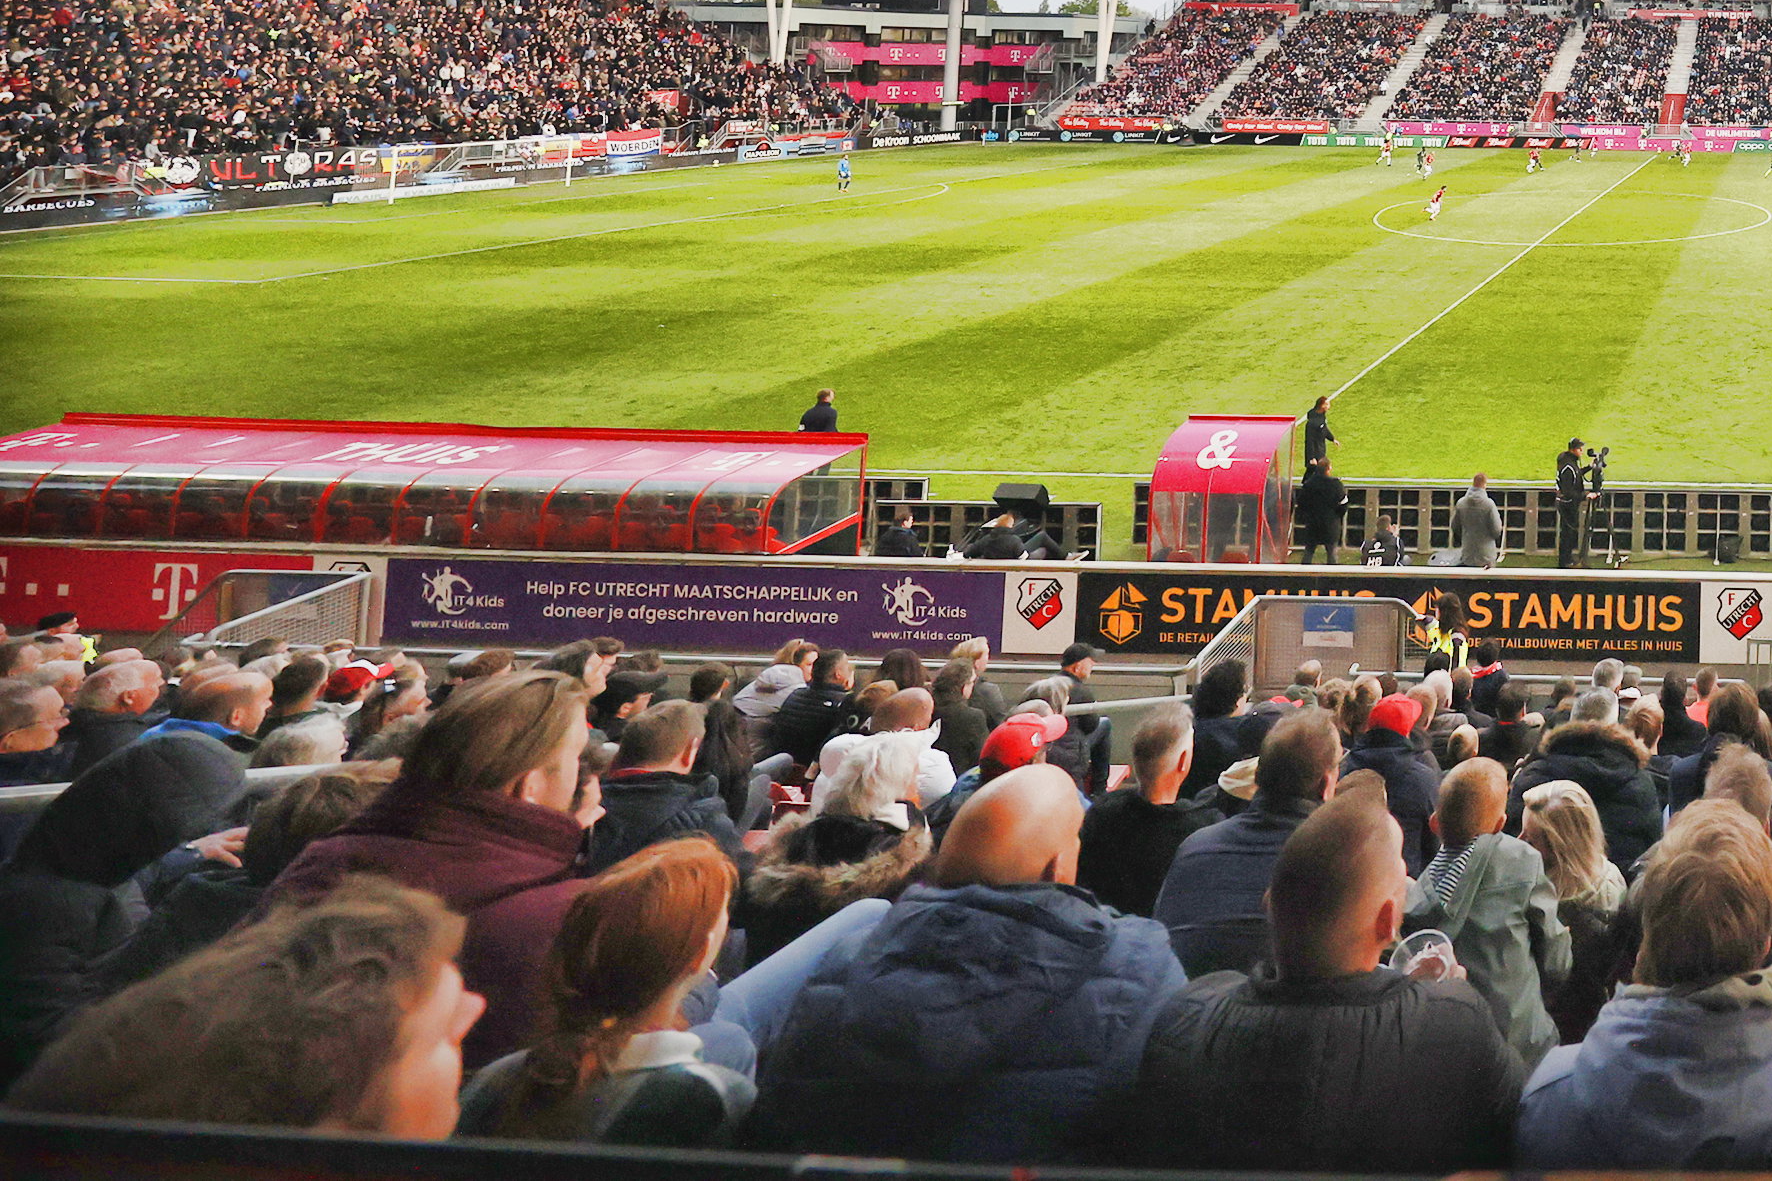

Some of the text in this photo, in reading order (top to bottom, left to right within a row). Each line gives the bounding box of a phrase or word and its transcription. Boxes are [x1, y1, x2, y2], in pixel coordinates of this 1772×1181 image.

[1226, 122, 1243, 131] Only
[1277, 123, 1293, 132] Only
[1580, 127, 1626, 136] WELKOM BIJ
[913, 133, 961, 145] SCHOONMAAK
[1706, 129, 1762, 138] DE UNLIMITEDS
[610, 139, 660, 153] WOERDEN
[1307, 136, 1328, 145] TOTO
[1336, 137, 1356, 146] TOTO
[1364, 137, 1385, 146] TOTO
[1393, 137, 1413, 147] TOTO
[1421, 137, 1442, 147] TOTO
[1739, 142, 1765, 151] oppo
[745, 149, 780, 159] NAPOLEON
[313, 441, 503, 464] THUIS
[1196, 429, 1239, 469] &
[151, 564, 198, 619] T
[526, 580, 858, 603] Help FC UTRECHT MAATSCHAPPELIJK en
[1028, 583, 1035, 595] F
[1022, 582, 1061, 619] UTRECHT
[1728, 592, 1735, 606] F
[542, 604, 839, 625] doneer je afgeschreven hardware
[1042, 605, 1053, 618] C
[1468, 591, 1684, 631] STAMHUIS
[1722, 592, 1761, 629] UTRECHT
[410, 619, 509, 630] www.IT4kids.com
[1742, 615, 1753, 628] C
[872, 630, 972, 642] www.IT4kids.com
[1160, 633, 1174, 643] DE
[1497, 639, 1572, 650] TAILBOUWER
[1576, 639, 1599, 650] MET
[1602, 639, 1638, 650] ALLES
[1640, 640, 1653, 650] IN
[1655, 640, 1683, 651] HUIS
